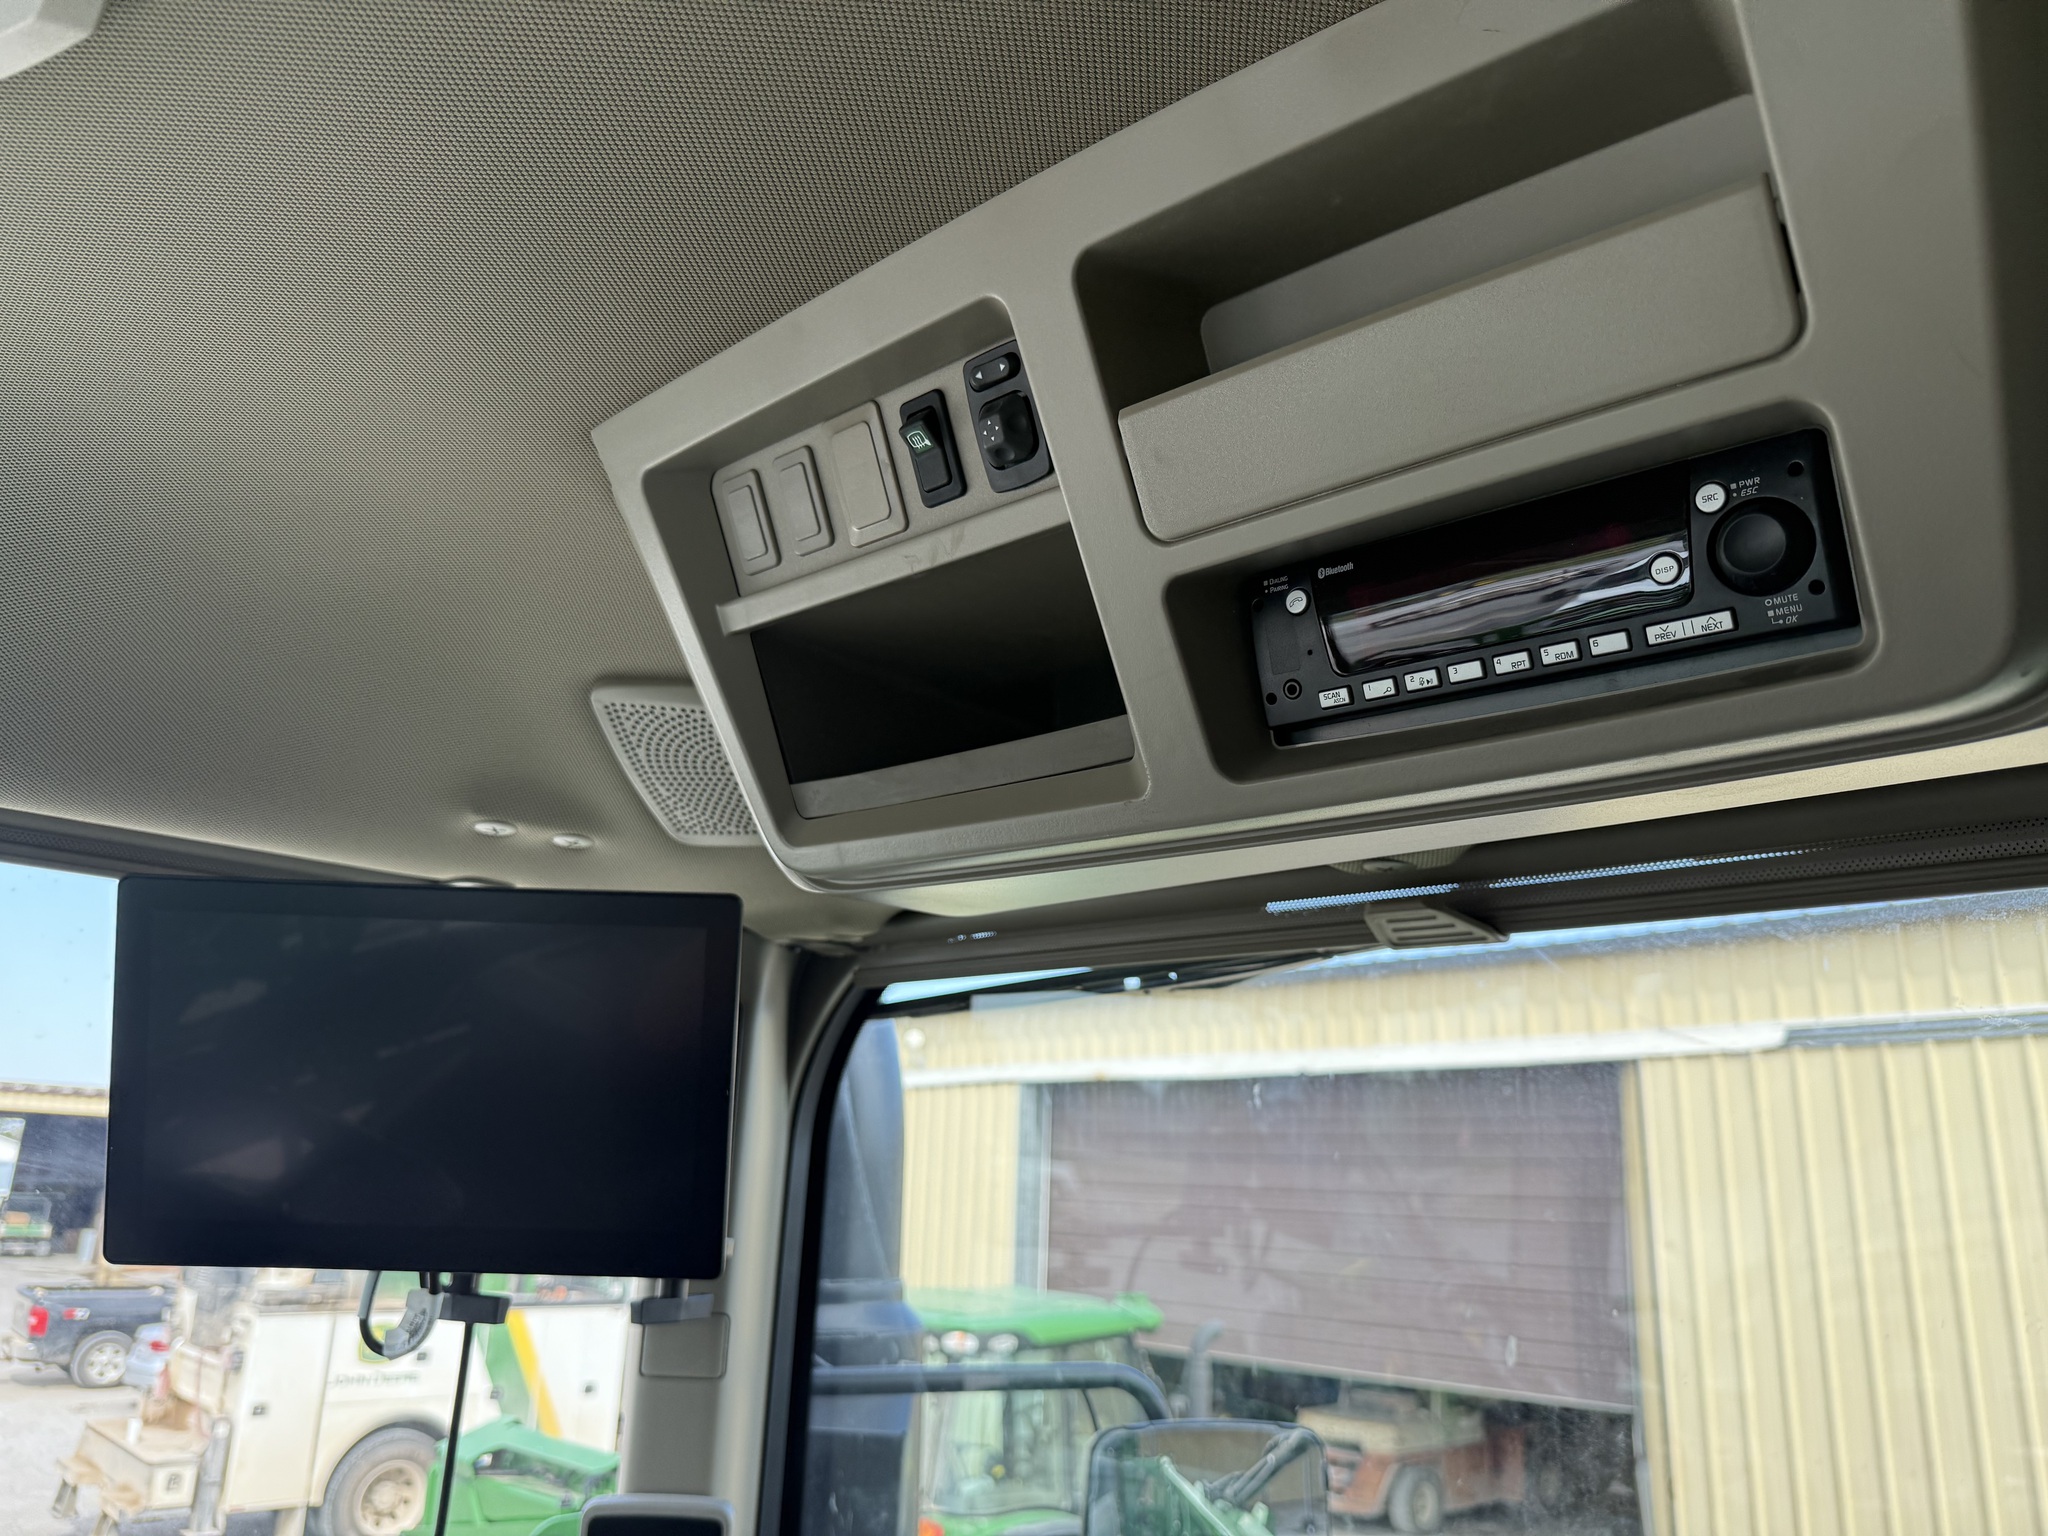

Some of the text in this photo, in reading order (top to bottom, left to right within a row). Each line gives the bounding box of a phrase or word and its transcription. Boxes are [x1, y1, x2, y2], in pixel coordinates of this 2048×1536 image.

[1739, 477, 1761, 488] PWR
[1741, 486, 1759, 497] ESC
[1701, 492, 1719, 504] SRC
[1325, 561, 1354, 576] Bluetooth
[1655, 565, 1675, 575] DISP
[1773, 593, 1799, 605] MUTE
[1775, 603, 1803, 616] MENU
[1785, 615, 1799, 624] OK
[1701, 621, 1723, 632] NEXT
[1654, 631, 1677, 642] PREV
[1592, 639, 1599, 648] 6
[1543, 649, 1575, 661] 5 RDM
[1510, 659, 1527, 670] RPT
[1452, 667, 1458, 675] 3
[1409, 675, 1415, 683] 2
[1323, 691, 1341, 701] SCAN
